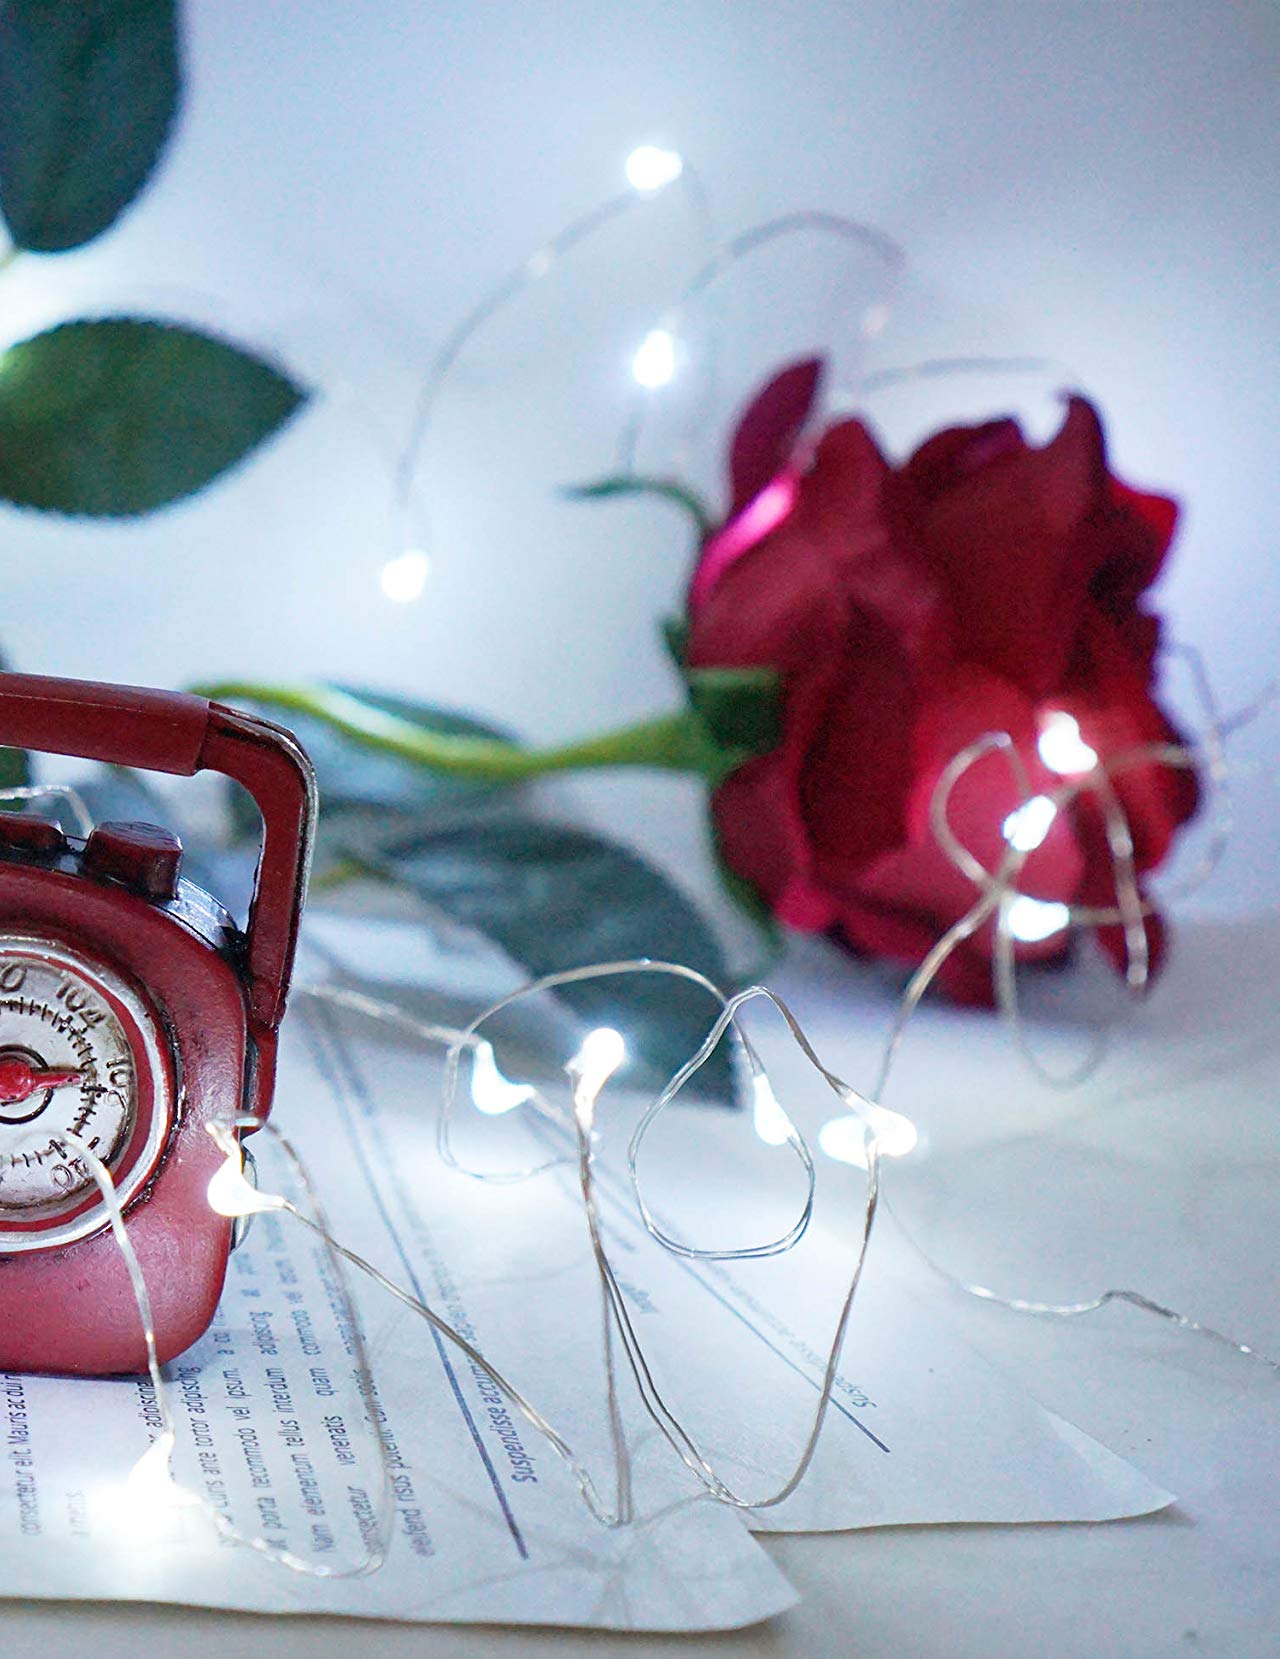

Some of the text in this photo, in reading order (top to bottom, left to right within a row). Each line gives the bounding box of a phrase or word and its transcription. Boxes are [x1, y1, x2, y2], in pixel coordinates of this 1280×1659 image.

[2, 1382, 24, 1397] dui
[176, 1367, 208, 1414] adipiscing
[307, 1368, 339, 1397] quam
[6, 1399, 26, 1410] ac
[228, 1405, 252, 1422] vel
[5, 1413, 33, 1445] Mauris
[189, 1418, 214, 1447] tortor
[321, 1415, 356, 1466] venenatis
[12, 1449, 33, 1467] elit.
[263, 1367, 335, 1553] Nam elementum tellus interdum
[487, 1408, 538, 1484] Suspendisse
[197, 1452, 221, 1475] ante
[389, 1476, 417, 1503] risus
[257, 1497, 288, 1530] porta
[392, 1510, 436, 1558] eleifend
